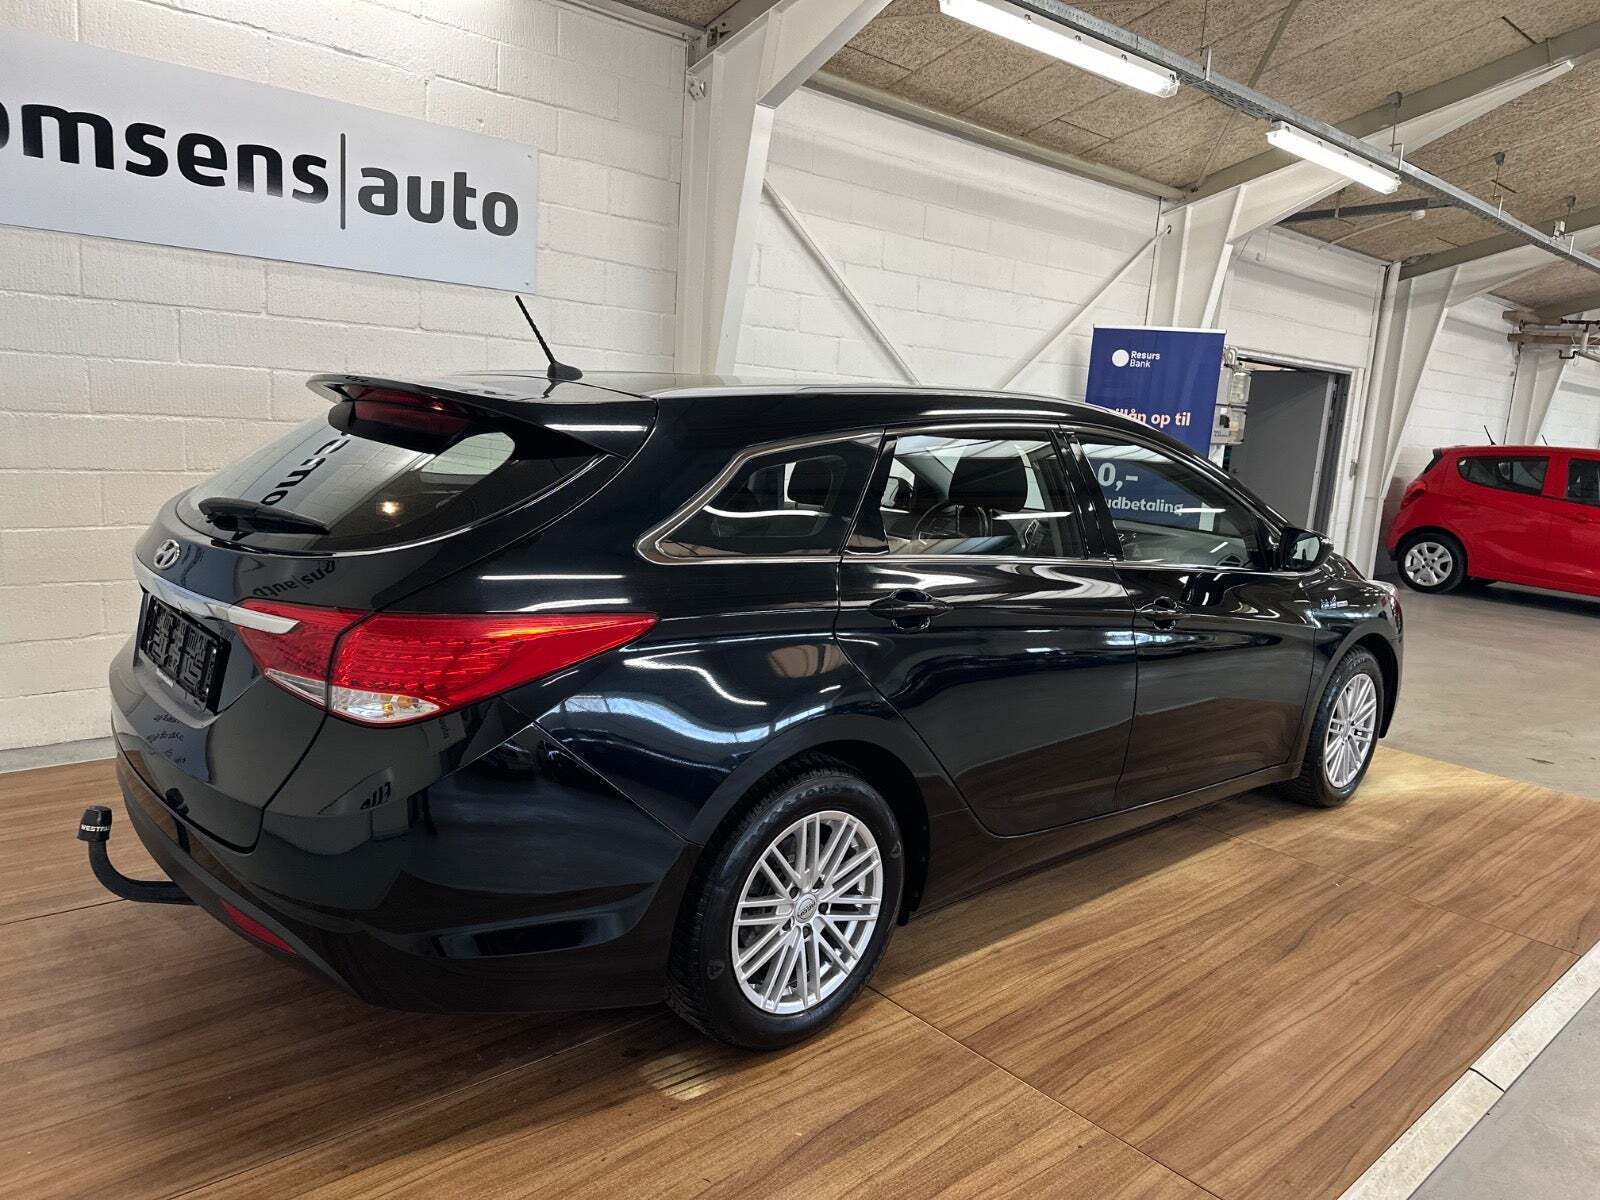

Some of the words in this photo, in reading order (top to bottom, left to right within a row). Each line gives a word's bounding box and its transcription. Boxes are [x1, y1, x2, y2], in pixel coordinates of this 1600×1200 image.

[0, 102, 329, 204] msens
[357, 166, 519, 237] auto
[1130, 350, 1161, 361] Resurs
[1129, 359, 1151, 368] Bank
[1150, 413, 1171, 429] op
[1174, 411, 1191, 426] til
